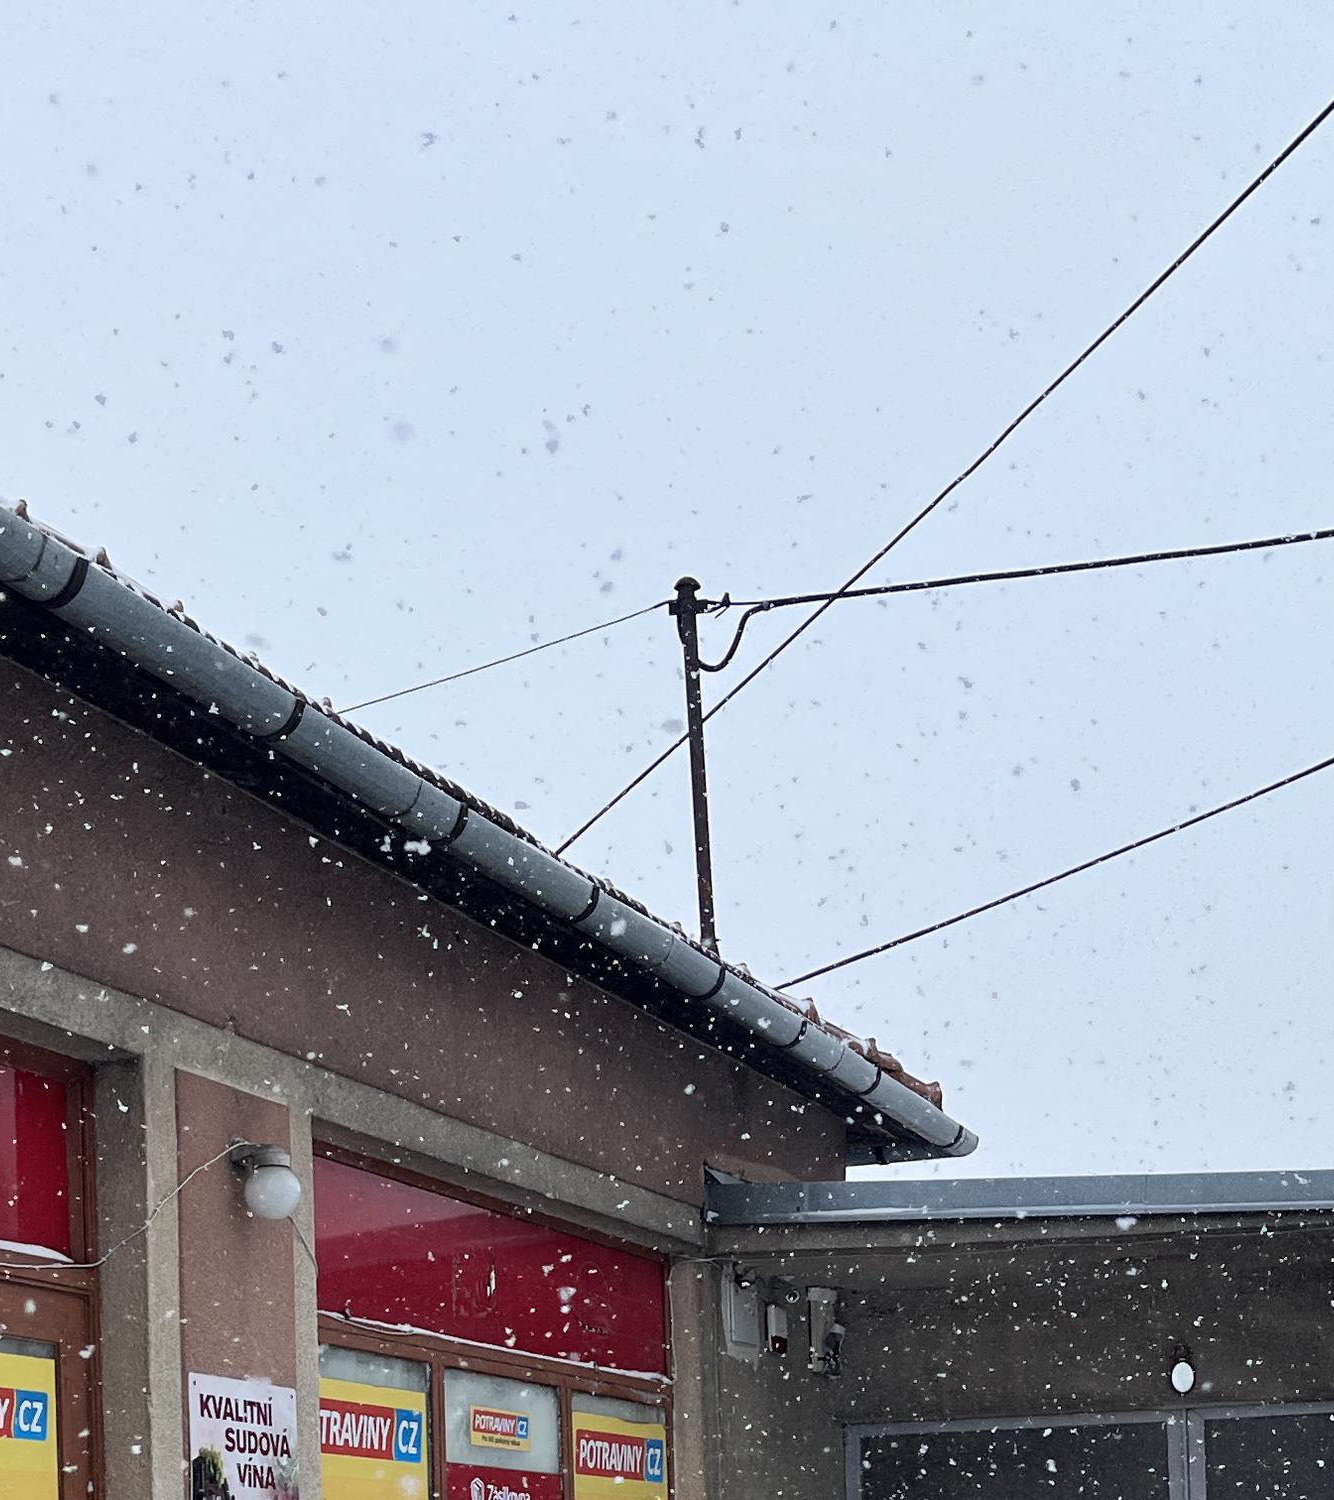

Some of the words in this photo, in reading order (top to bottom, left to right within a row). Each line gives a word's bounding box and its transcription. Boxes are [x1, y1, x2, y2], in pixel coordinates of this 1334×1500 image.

[19, 1401, 43, 1432] CZ
[199, 1393, 273, 1426] KVALITNÍ
[475, 1414, 516, 1434] POTRAVINY
[518, 1420, 527, 1435] CZ
[225, 1427, 292, 1458] SUDOVÁ
[320, 1409, 391, 1451] TRAVINY
[398, 1420, 418, 1454] CZ
[237, 1457, 276, 1490] VÍNA
[579, 1439, 642, 1473] POTRAVINY
[648, 1448, 661, 1476] CZ
